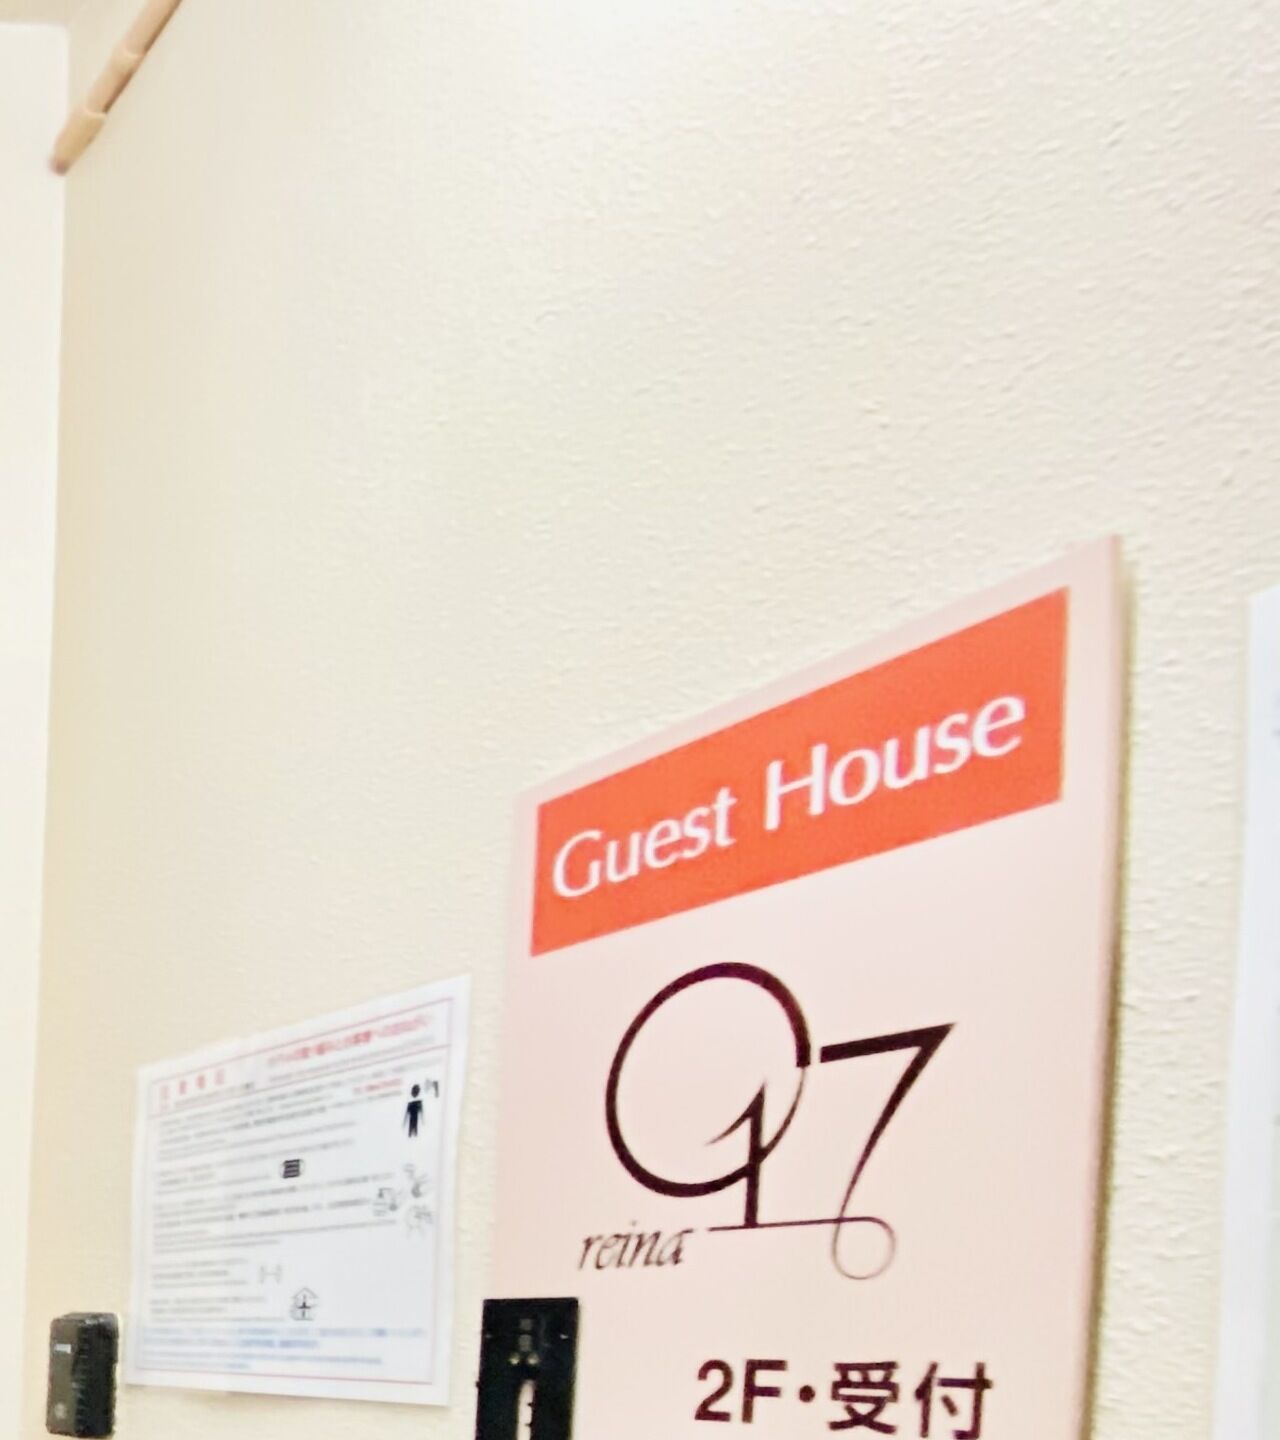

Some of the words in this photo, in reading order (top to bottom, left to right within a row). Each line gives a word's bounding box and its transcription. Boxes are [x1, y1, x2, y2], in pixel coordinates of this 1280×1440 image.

[552, 787, 737, 898] Guest
[765, 696, 1026, 831] House
[578, 1221, 700, 1271] reina
